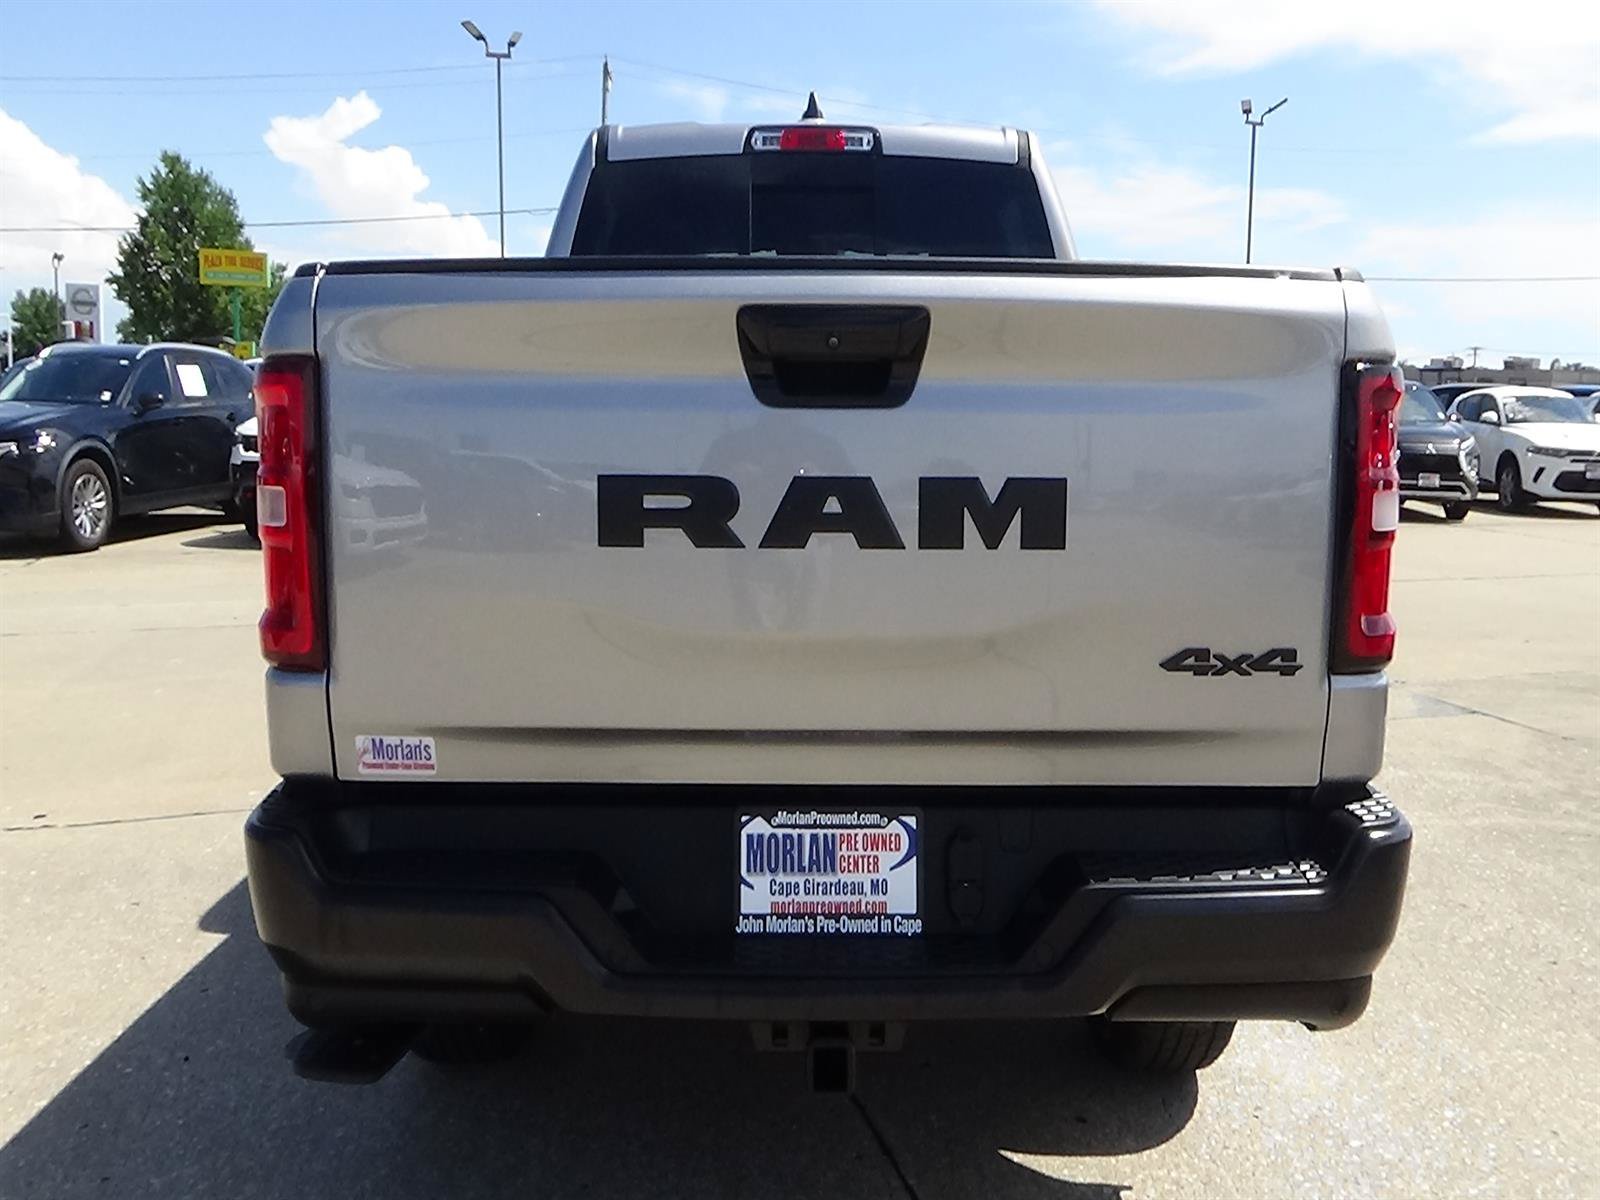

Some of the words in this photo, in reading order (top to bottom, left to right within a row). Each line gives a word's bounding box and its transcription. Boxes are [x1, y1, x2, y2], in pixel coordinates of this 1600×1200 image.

[597, 474, 1067, 550] RAM
[1159, 647, 1303, 676] 4x4
[777, 811, 881, 826] MorlanPreowned.com
[839, 833, 859, 851] PRE
[862, 833, 901, 851] OWNED
[746, 833, 837, 873] MORLAN
[839, 855, 880, 874] CENTER
[769, 878, 800, 897] Cape
[803, 878, 867, 897] Girardeau,
[870, 879, 888, 896] MO
[770, 898, 888, 914] morlanpreowned.com
[735, 916, 763, 933] John
[766, 916, 815, 933] Morlan's
[817, 916, 878, 933] Pre-Owned
[881, 916, 891, 933] in
[894, 916, 922, 936] Cape
